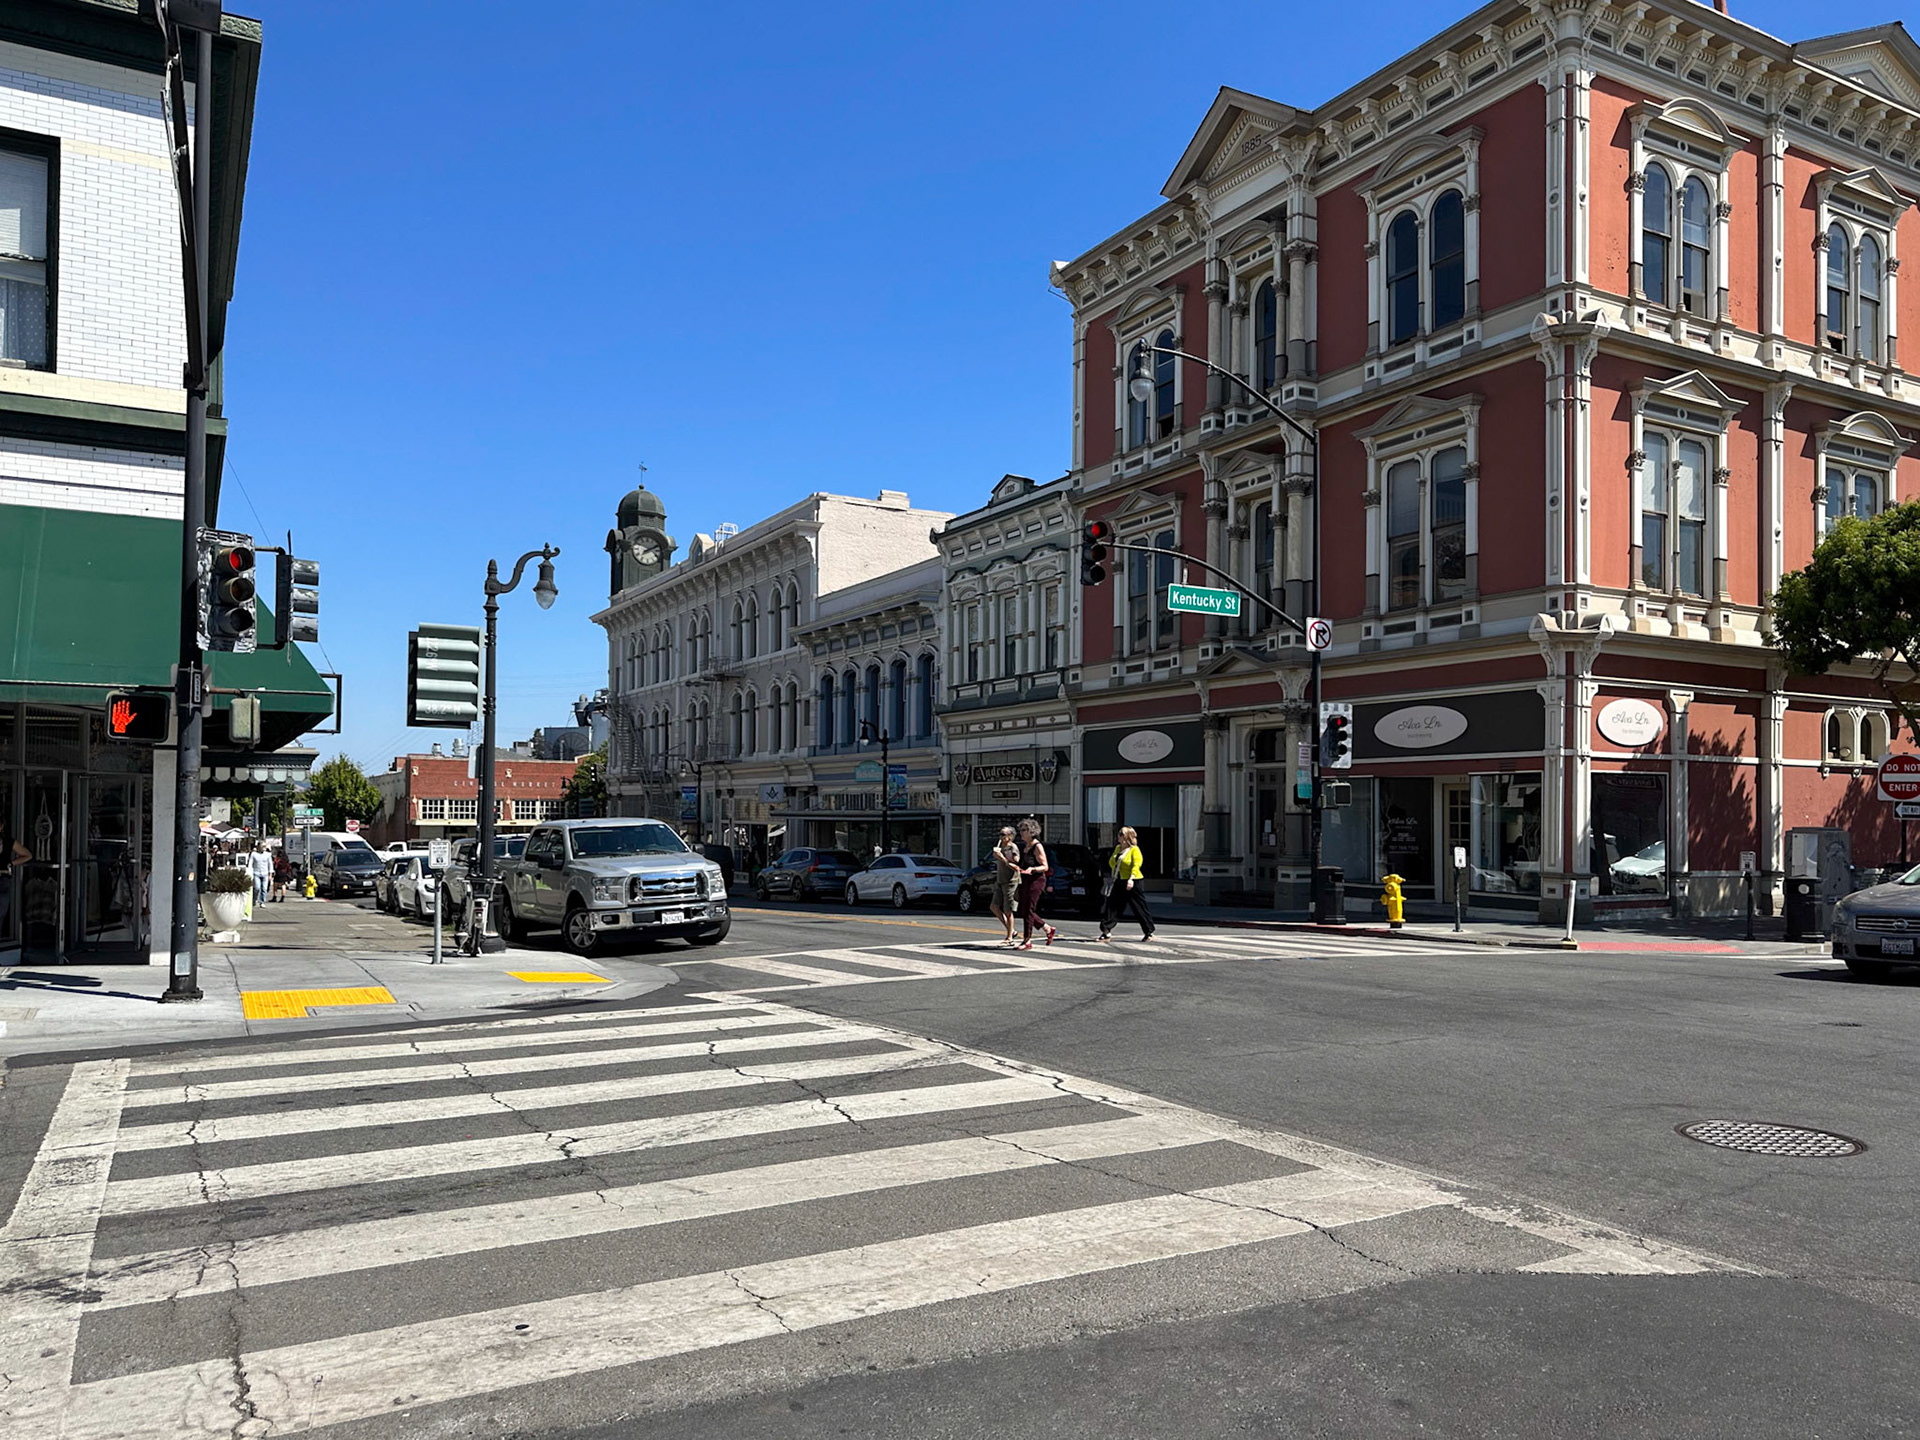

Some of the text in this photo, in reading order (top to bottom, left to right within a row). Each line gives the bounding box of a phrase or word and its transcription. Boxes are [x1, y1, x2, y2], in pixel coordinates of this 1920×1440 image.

[1241, 134, 1262, 156] 1885
[1173, 590, 1236, 611] Kentucky St
[975, 765, 1031, 781] Andresen's
[1886, 763, 1920, 772] DO NOT
[1889, 783, 1918, 792] ENTER
